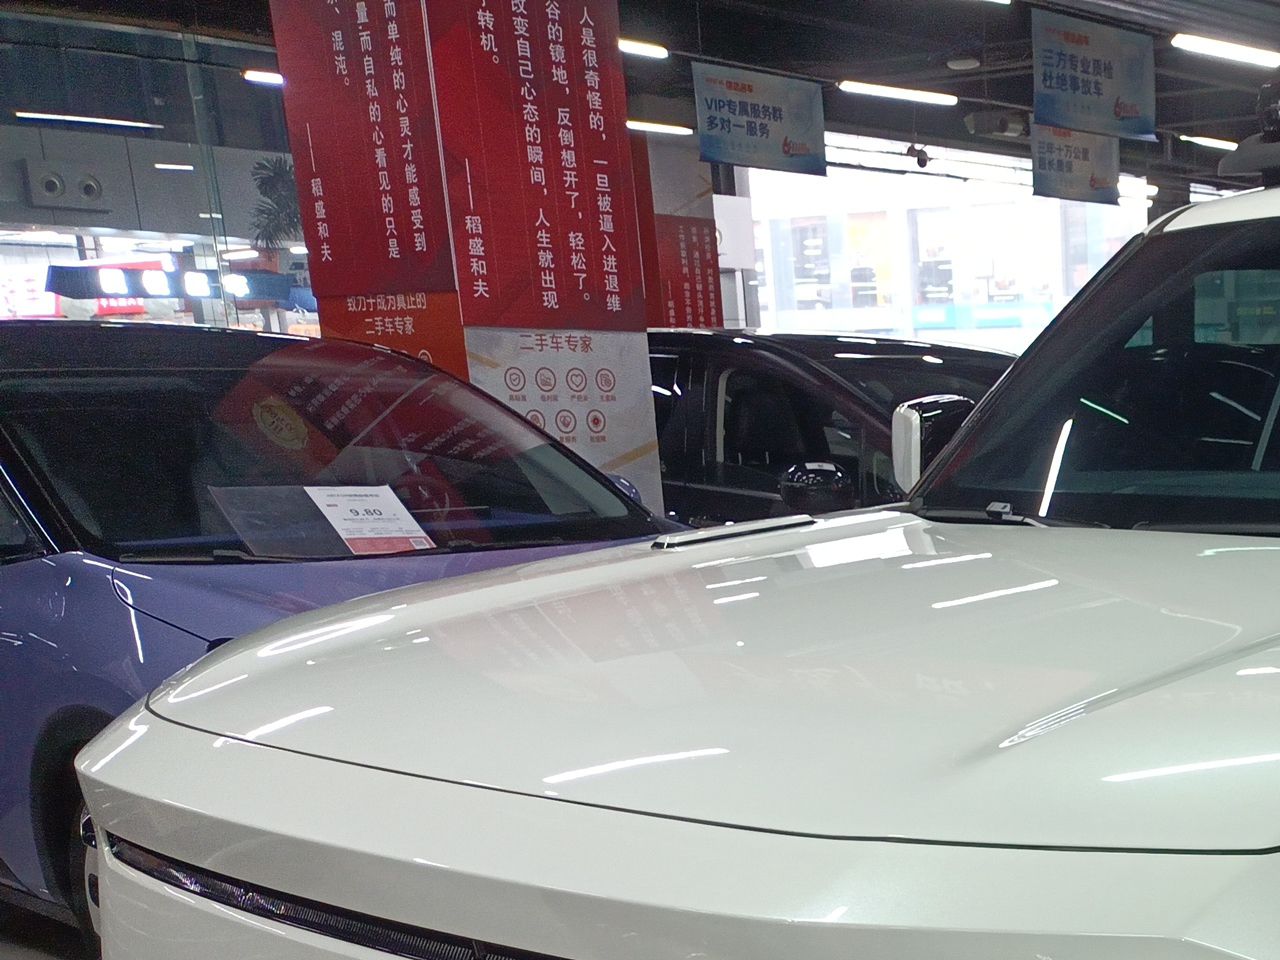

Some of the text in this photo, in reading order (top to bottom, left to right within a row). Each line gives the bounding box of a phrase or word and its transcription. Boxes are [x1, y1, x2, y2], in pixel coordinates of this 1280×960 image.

[706, 115, 770, 139] 多对一服务
[364, 315, 415, 336] 二手车专家
[519, 333, 594, 354] 二手车专家
[349, 508, 383, 517] 9.80
